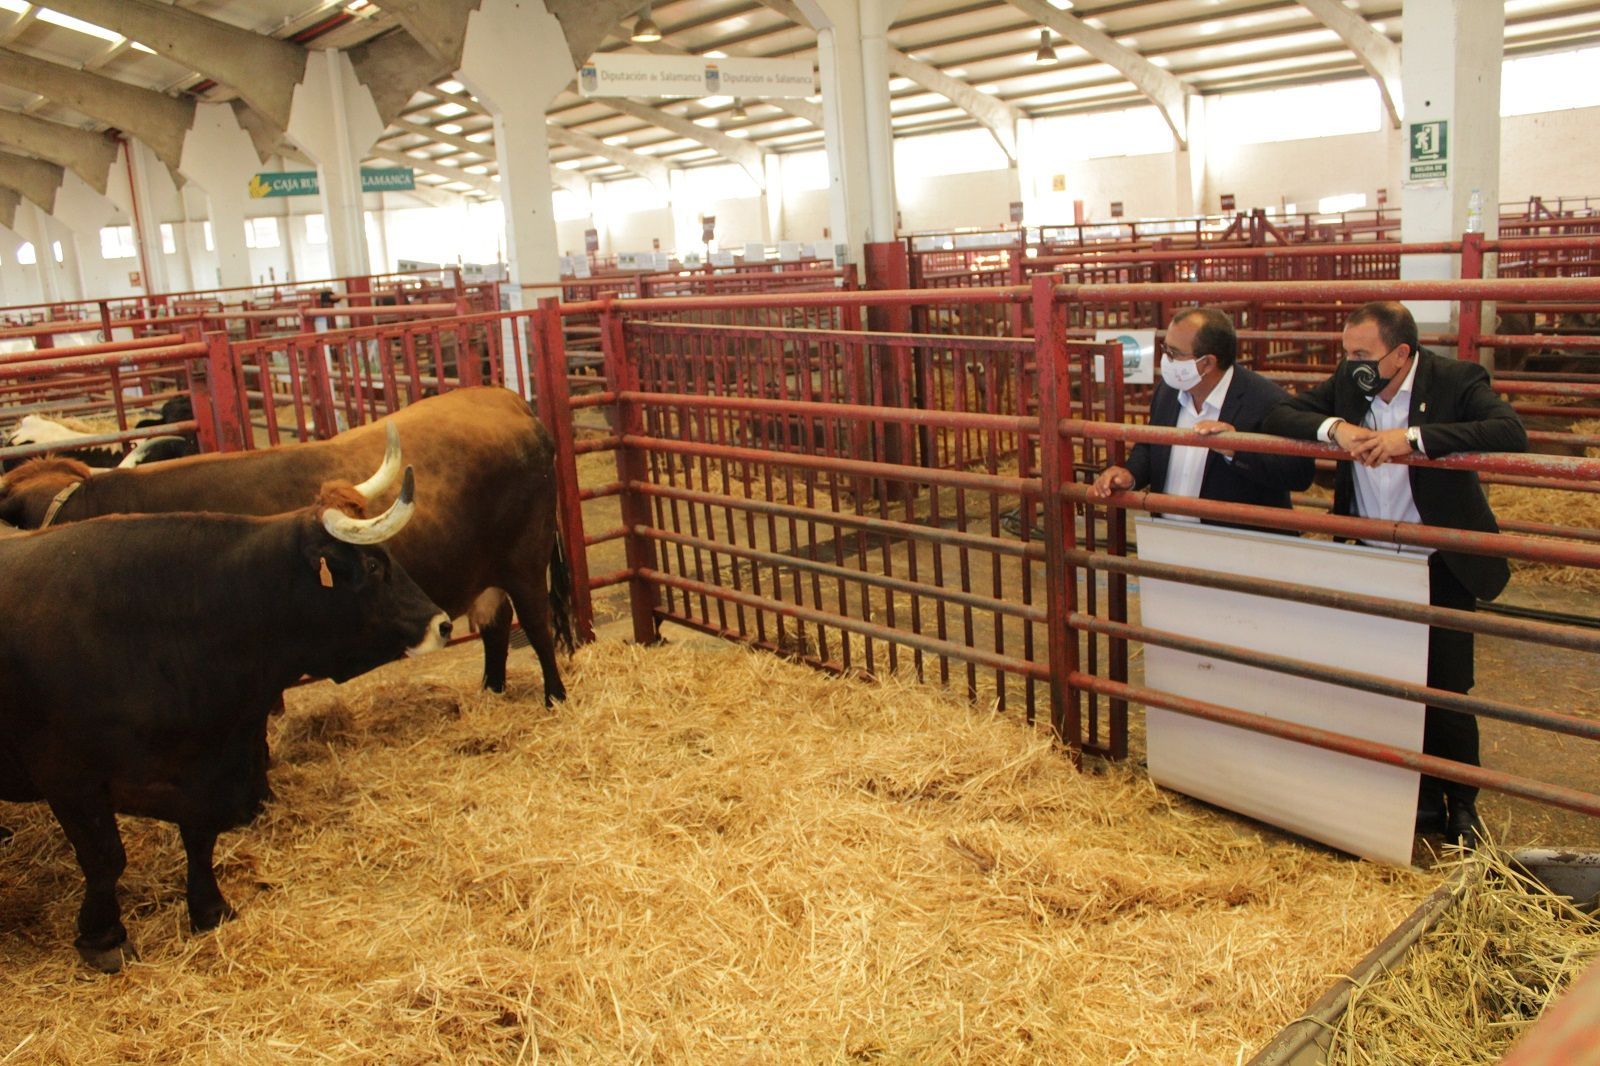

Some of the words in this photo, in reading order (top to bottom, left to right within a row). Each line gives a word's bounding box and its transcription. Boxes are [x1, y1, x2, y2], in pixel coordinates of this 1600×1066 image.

[601, 70, 648, 83] Diputación
[660, 71, 701, 82] Salamanca
[722, 72, 764, 83] Diputación
[776, 73, 812, 84] Salamanca
[273, 178, 299, 192] CAJA
